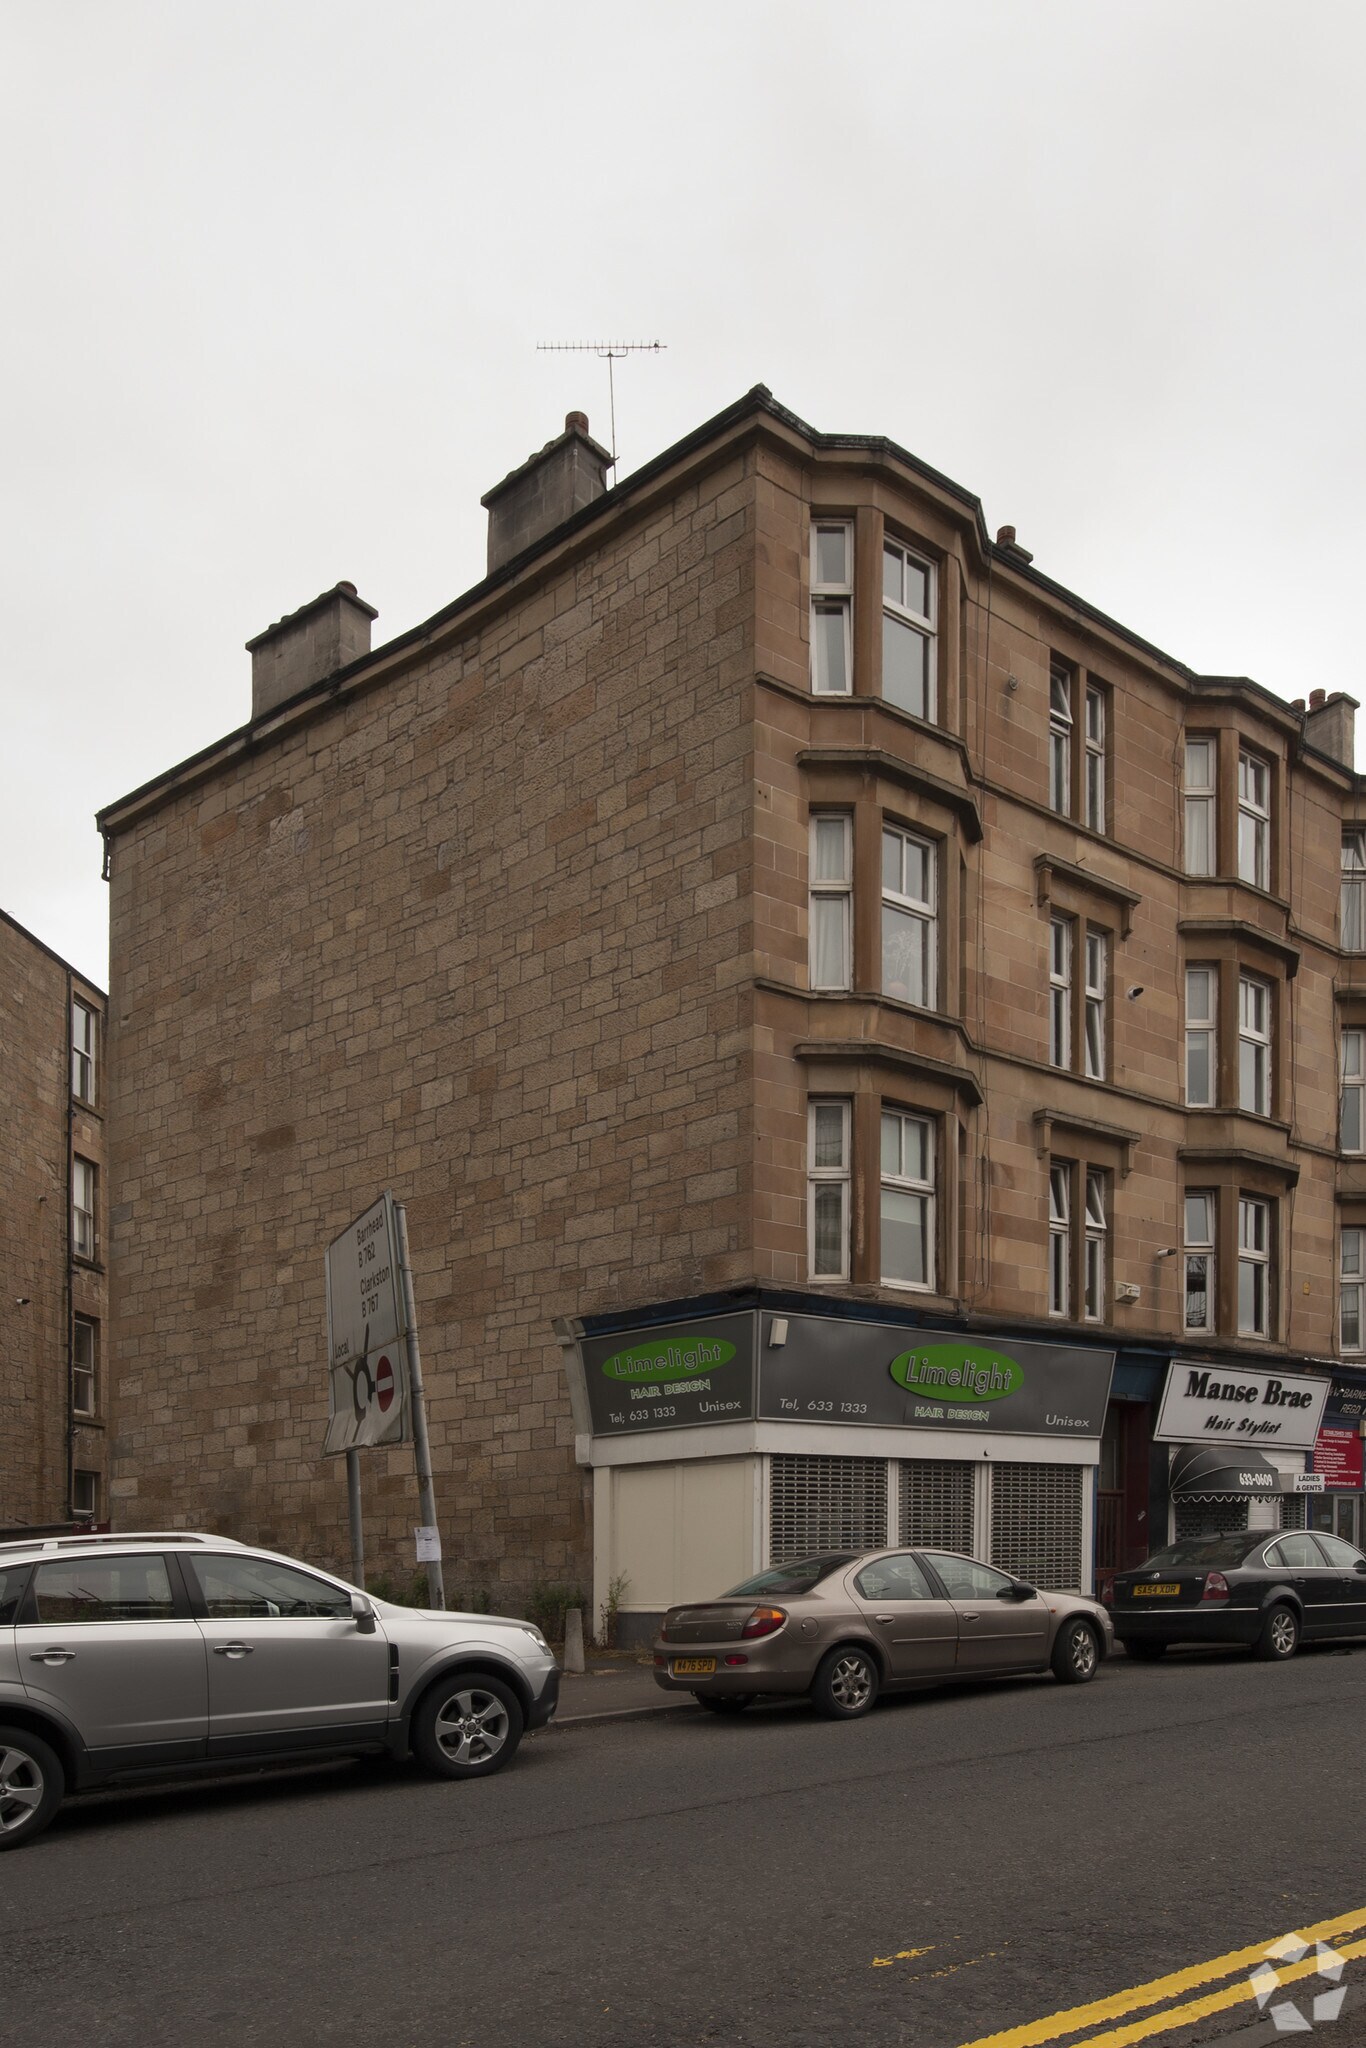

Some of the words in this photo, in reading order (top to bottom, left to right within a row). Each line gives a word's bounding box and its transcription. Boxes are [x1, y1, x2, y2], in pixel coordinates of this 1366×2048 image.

[357, 1210, 383, 1246] Barrhead
[358, 1251, 363, 1268] B
[363, 1241, 376, 1265] 762
[360, 1266, 390, 1295] Clarkston
[362, 1301, 367, 1318] B
[367, 1293, 379, 1314] 767
[335, 1337, 349, 1359] Local
[614, 1343, 721, 1375] Limelight
[906, 1355, 1012, 1396] Limelight
[630, 1385, 661, 1400] HAIR
[664, 1379, 711, 1396] DESIGN
[1184, 1370, 1259, 1403] Manse
[1262, 1379, 1313, 1409] Brae
[629, 1409, 649, 1421] 633
[653, 1406, 676, 1419] 1333
[699, 1400, 742, 1413] Unisex
[807, 1400, 833, 1412] 633
[840, 1401, 867, 1414] 1333
[914, 1406, 944, 1419] HAIR
[947, 1408, 989, 1422] DESIGN
[1045, 1414, 1090, 1428] Unisex
[1204, 1415, 1236, 1430] Hair
[1238, 1417, 1282, 1437] Stylist
[1239, 1472, 1273, 1487] 633-0609
[1298, 1475, 1320, 1483] LADIES
